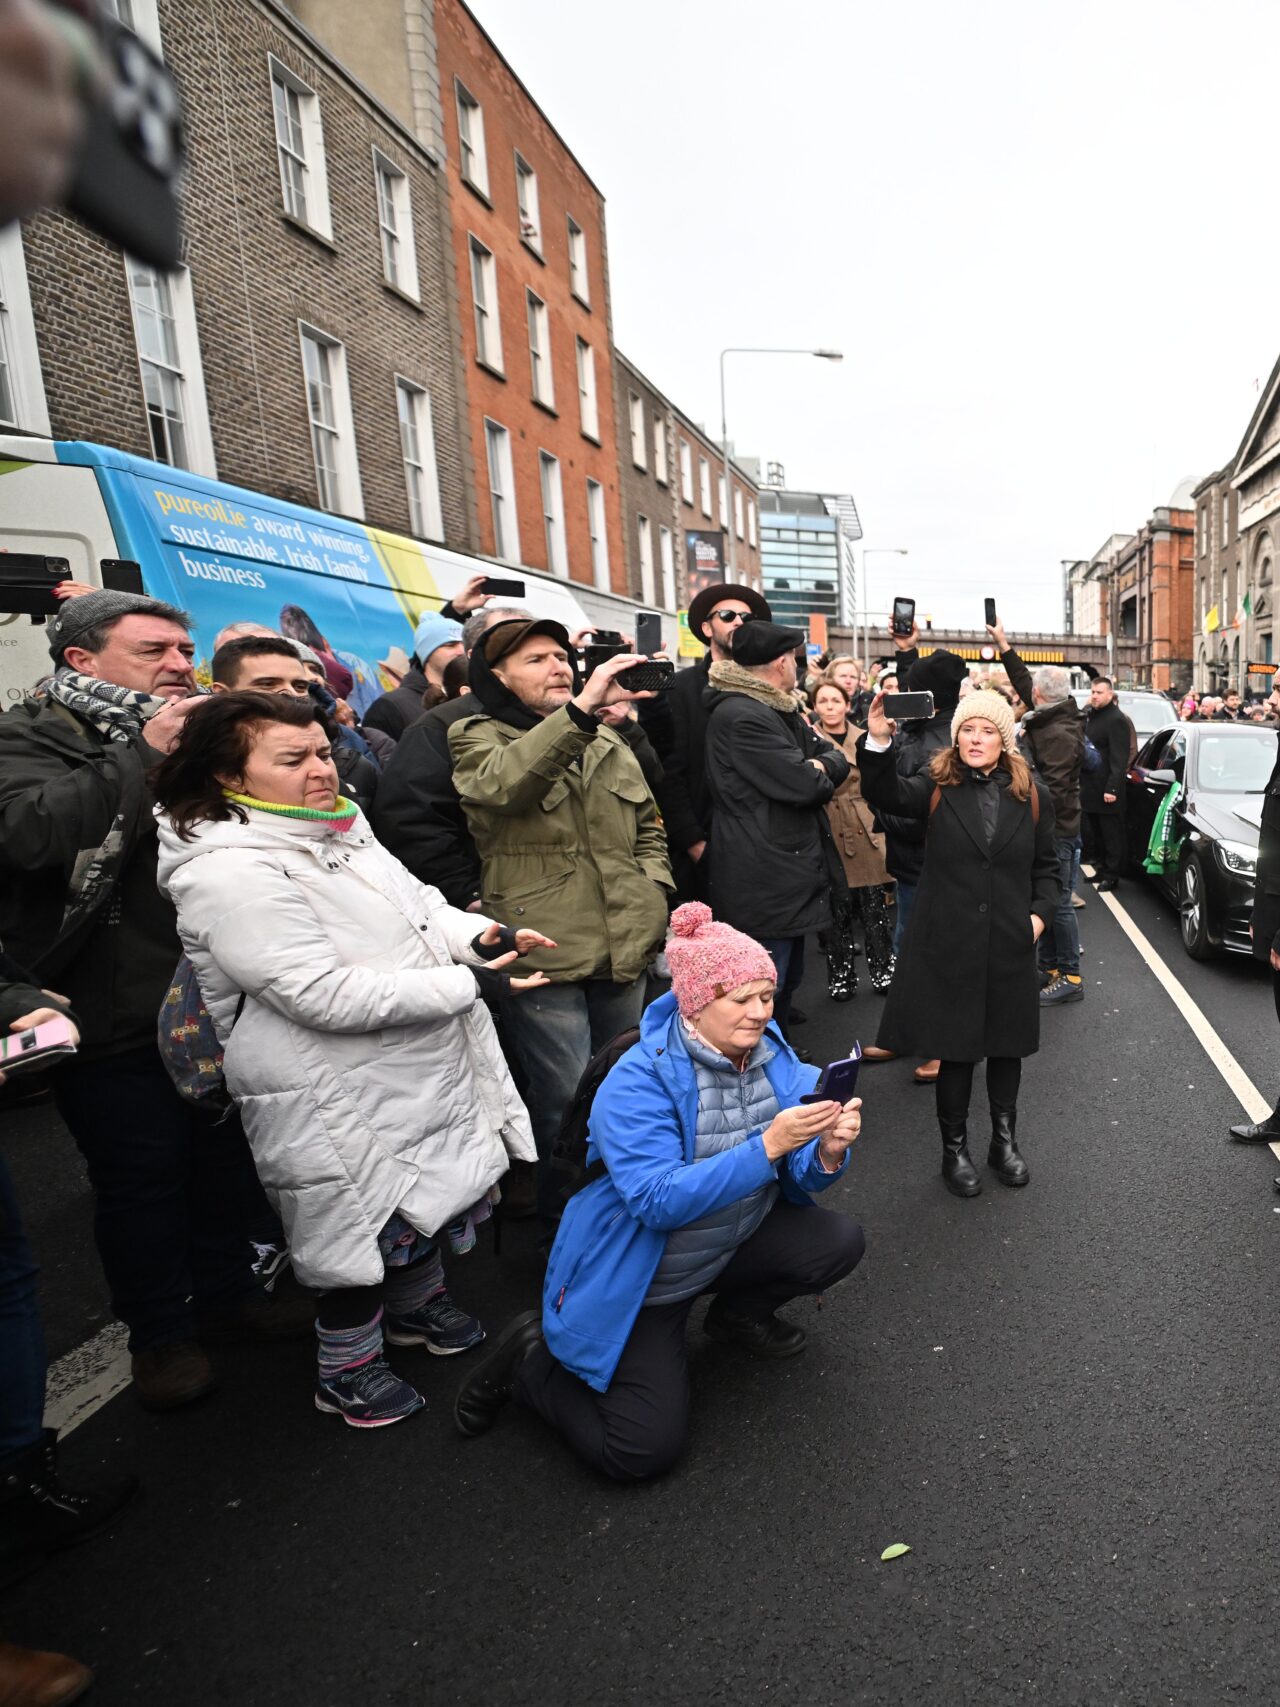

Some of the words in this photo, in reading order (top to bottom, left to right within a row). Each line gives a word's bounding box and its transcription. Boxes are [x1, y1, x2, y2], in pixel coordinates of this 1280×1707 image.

[154, 490, 247, 528] pureoil.ie
[251, 515, 307, 543] award
[307, 528, 370, 563] winning,
[169, 524, 286, 566] sustainable,
[283, 544, 324, 572] Irish
[322, 553, 368, 582] family
[178, 550, 266, 589] business
